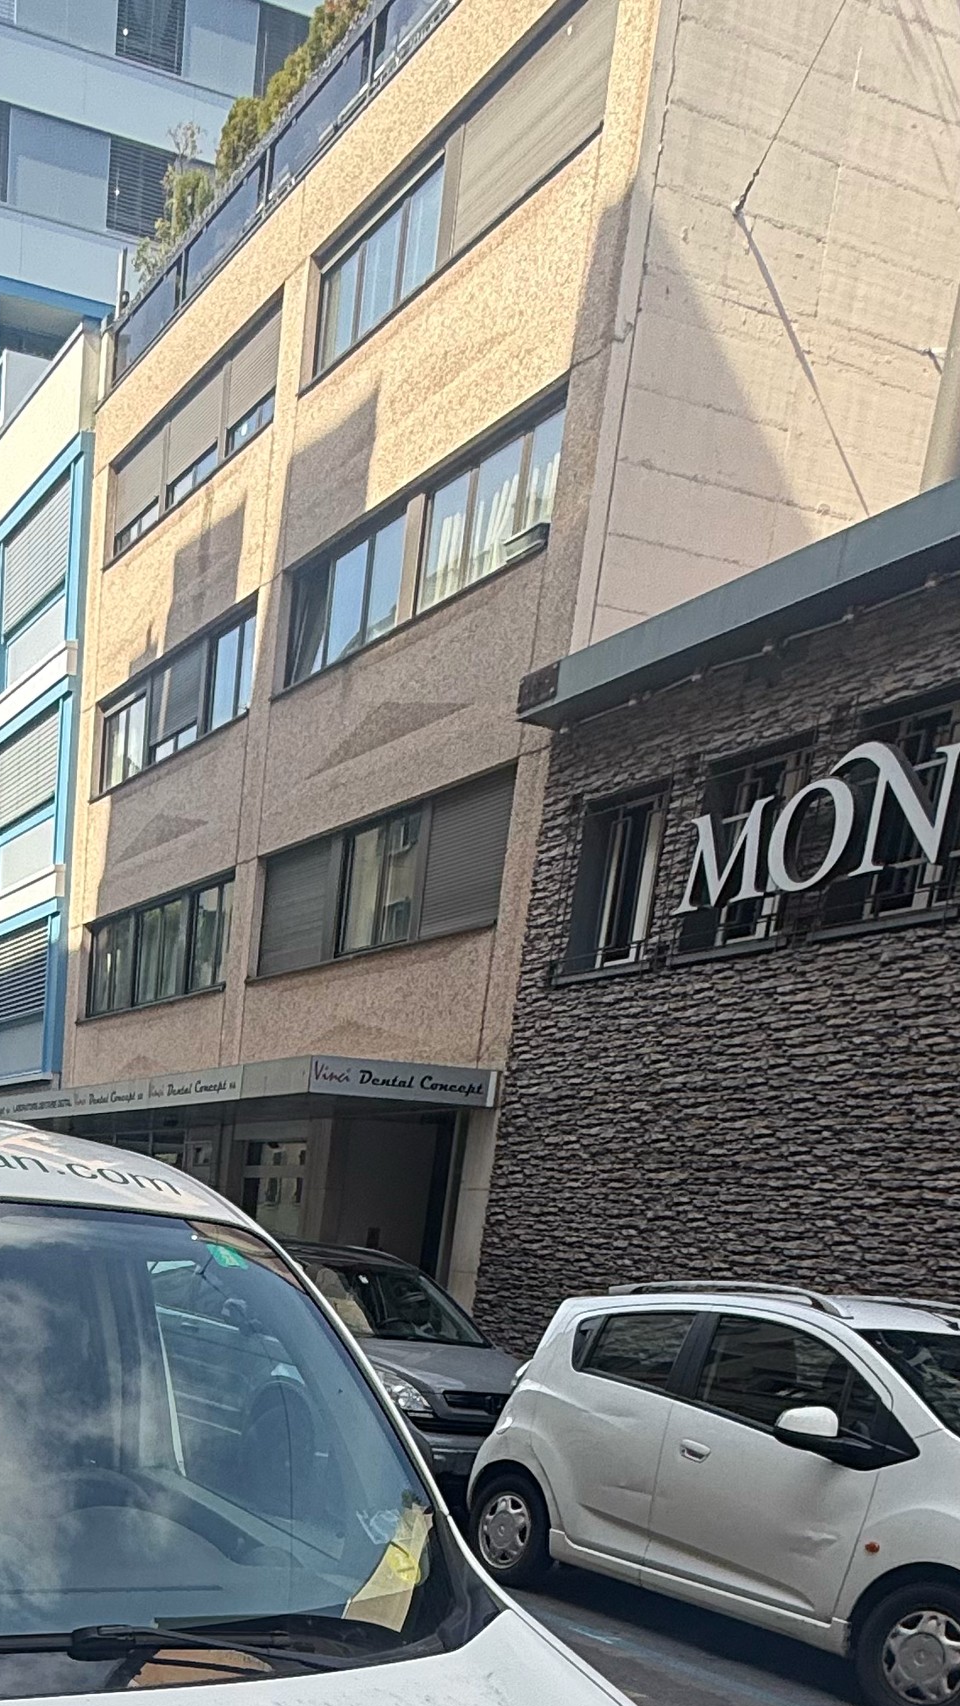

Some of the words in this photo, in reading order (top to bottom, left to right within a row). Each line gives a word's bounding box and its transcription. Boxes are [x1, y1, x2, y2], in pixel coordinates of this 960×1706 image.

[672, 741, 960, 916] MON
[194, 1079, 227, 1095] Concept
[314, 1059, 351, 1083] Vinci
[359, 1069, 414, 1089] Dental
[420, 1075, 484, 1097] Concept
